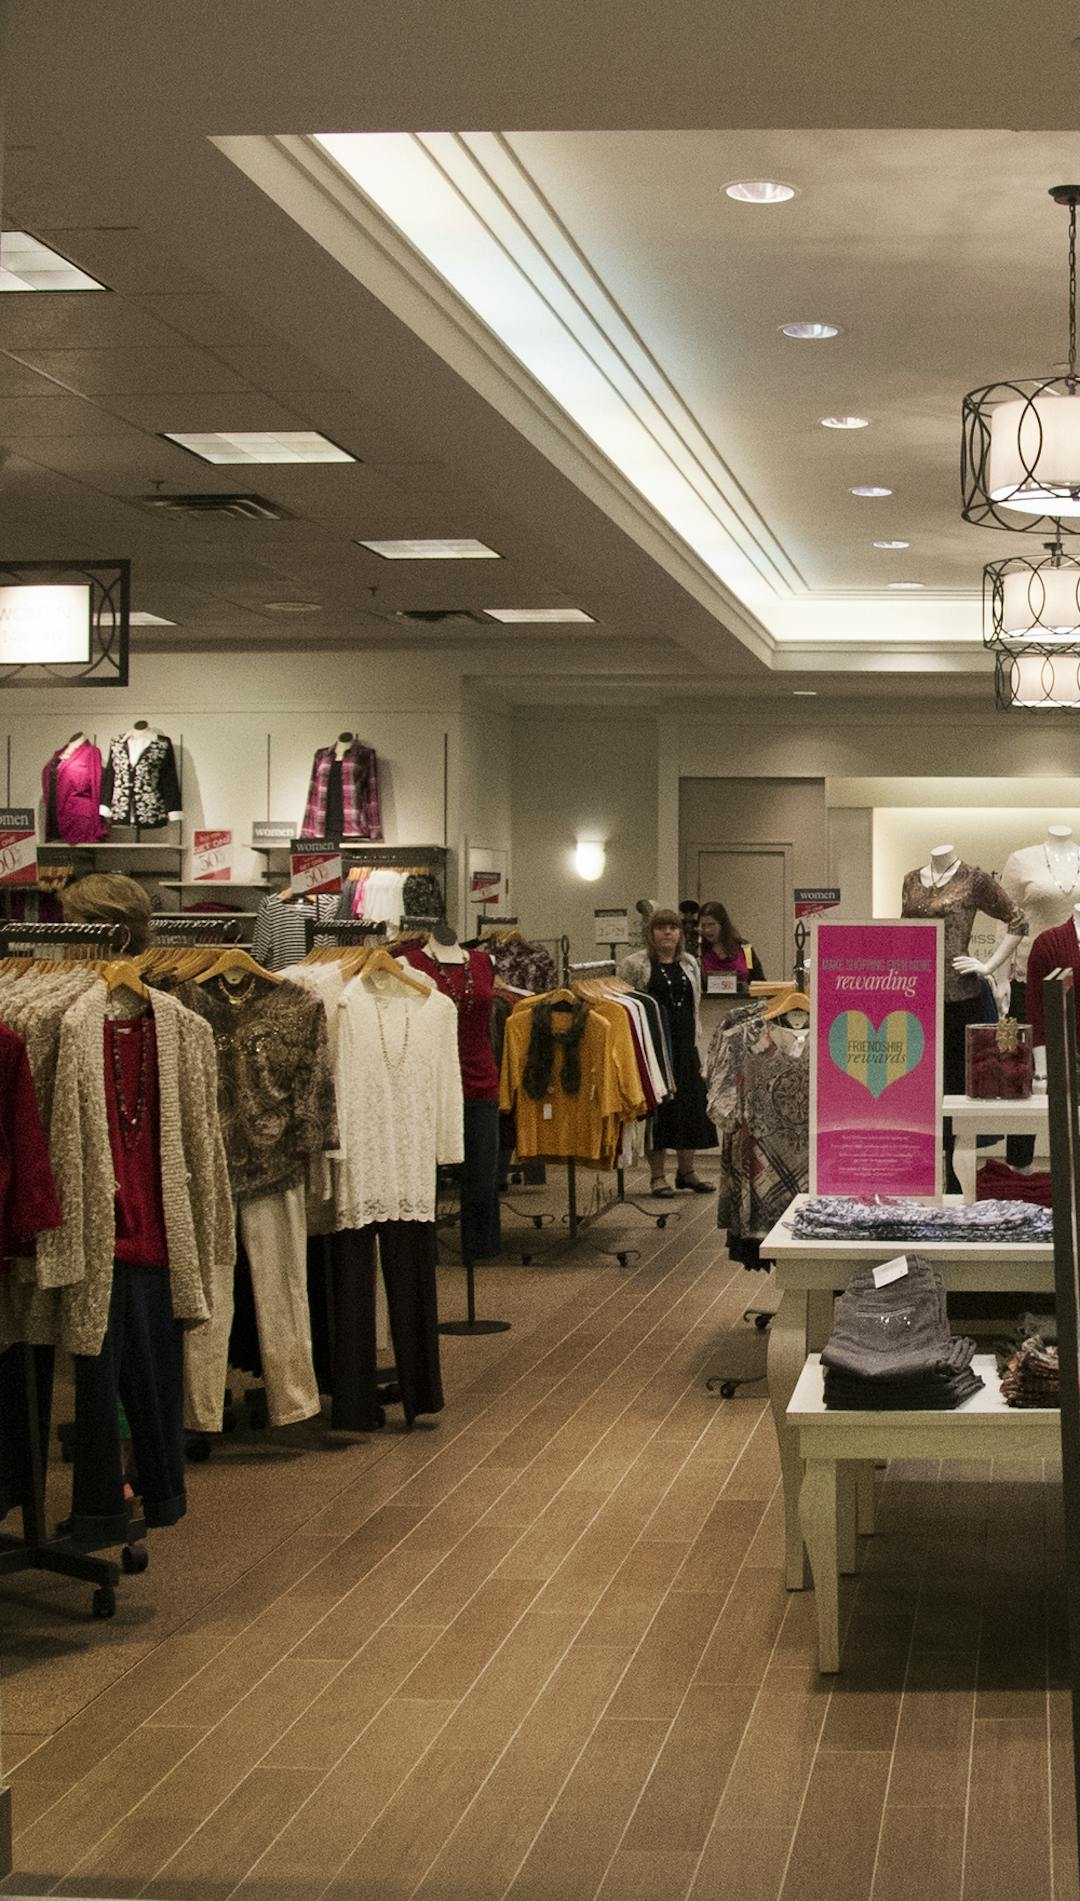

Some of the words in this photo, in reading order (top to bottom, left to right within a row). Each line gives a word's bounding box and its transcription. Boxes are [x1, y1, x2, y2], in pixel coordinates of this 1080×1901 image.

[0, 814, 28, 825] men
[255, 828, 294, 837] women
[296, 842, 335, 851] women
[836, 969, 918, 997] rewarding
[848, 1040, 903, 1053] FRIENDSHIP
[848, 1049, 906, 1064] rewards
